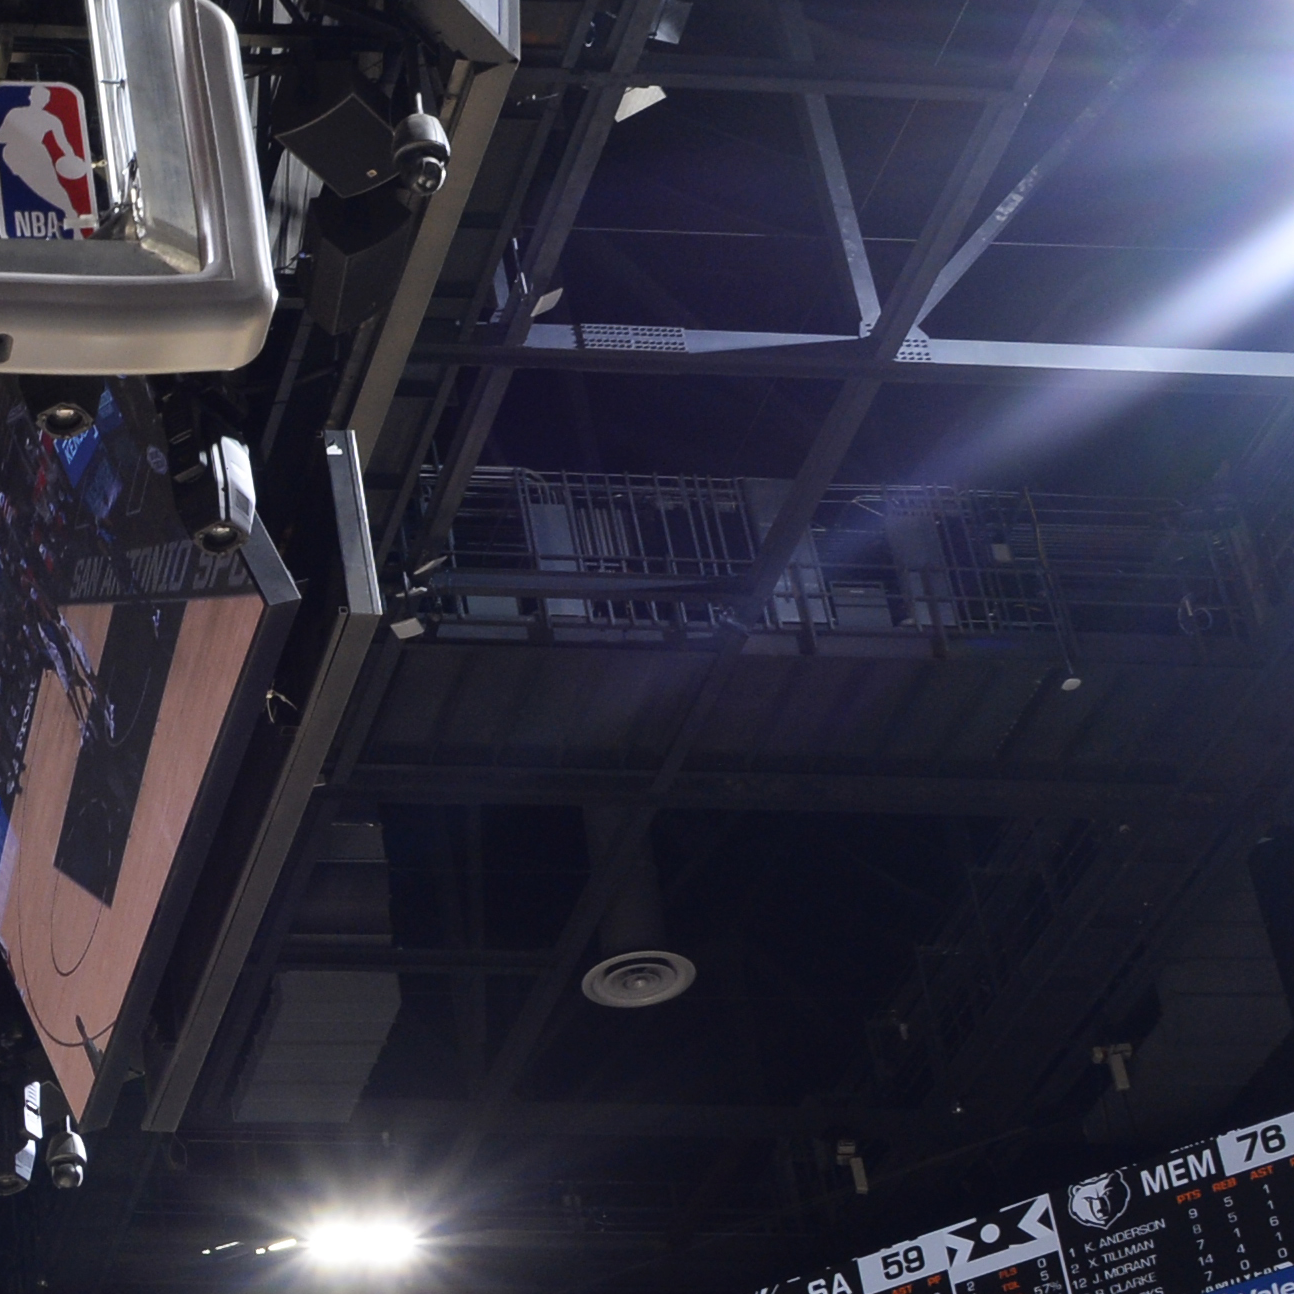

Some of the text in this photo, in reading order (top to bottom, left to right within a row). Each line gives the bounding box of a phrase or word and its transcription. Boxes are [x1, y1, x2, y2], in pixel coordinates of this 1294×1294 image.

[14, 210, 59, 238] NBA
[1139, 1124, 1287, 1197] MEM 76
[1098, 1218, 1167, 1250] ANDERSON
[880, 1245, 926, 1282] 59
[1101, 1239, 1156, 1264] TILLMAN
[1198, 1254, 1214, 1266] 14
[1072, 1254, 1158, 1291] 12 MORANT
